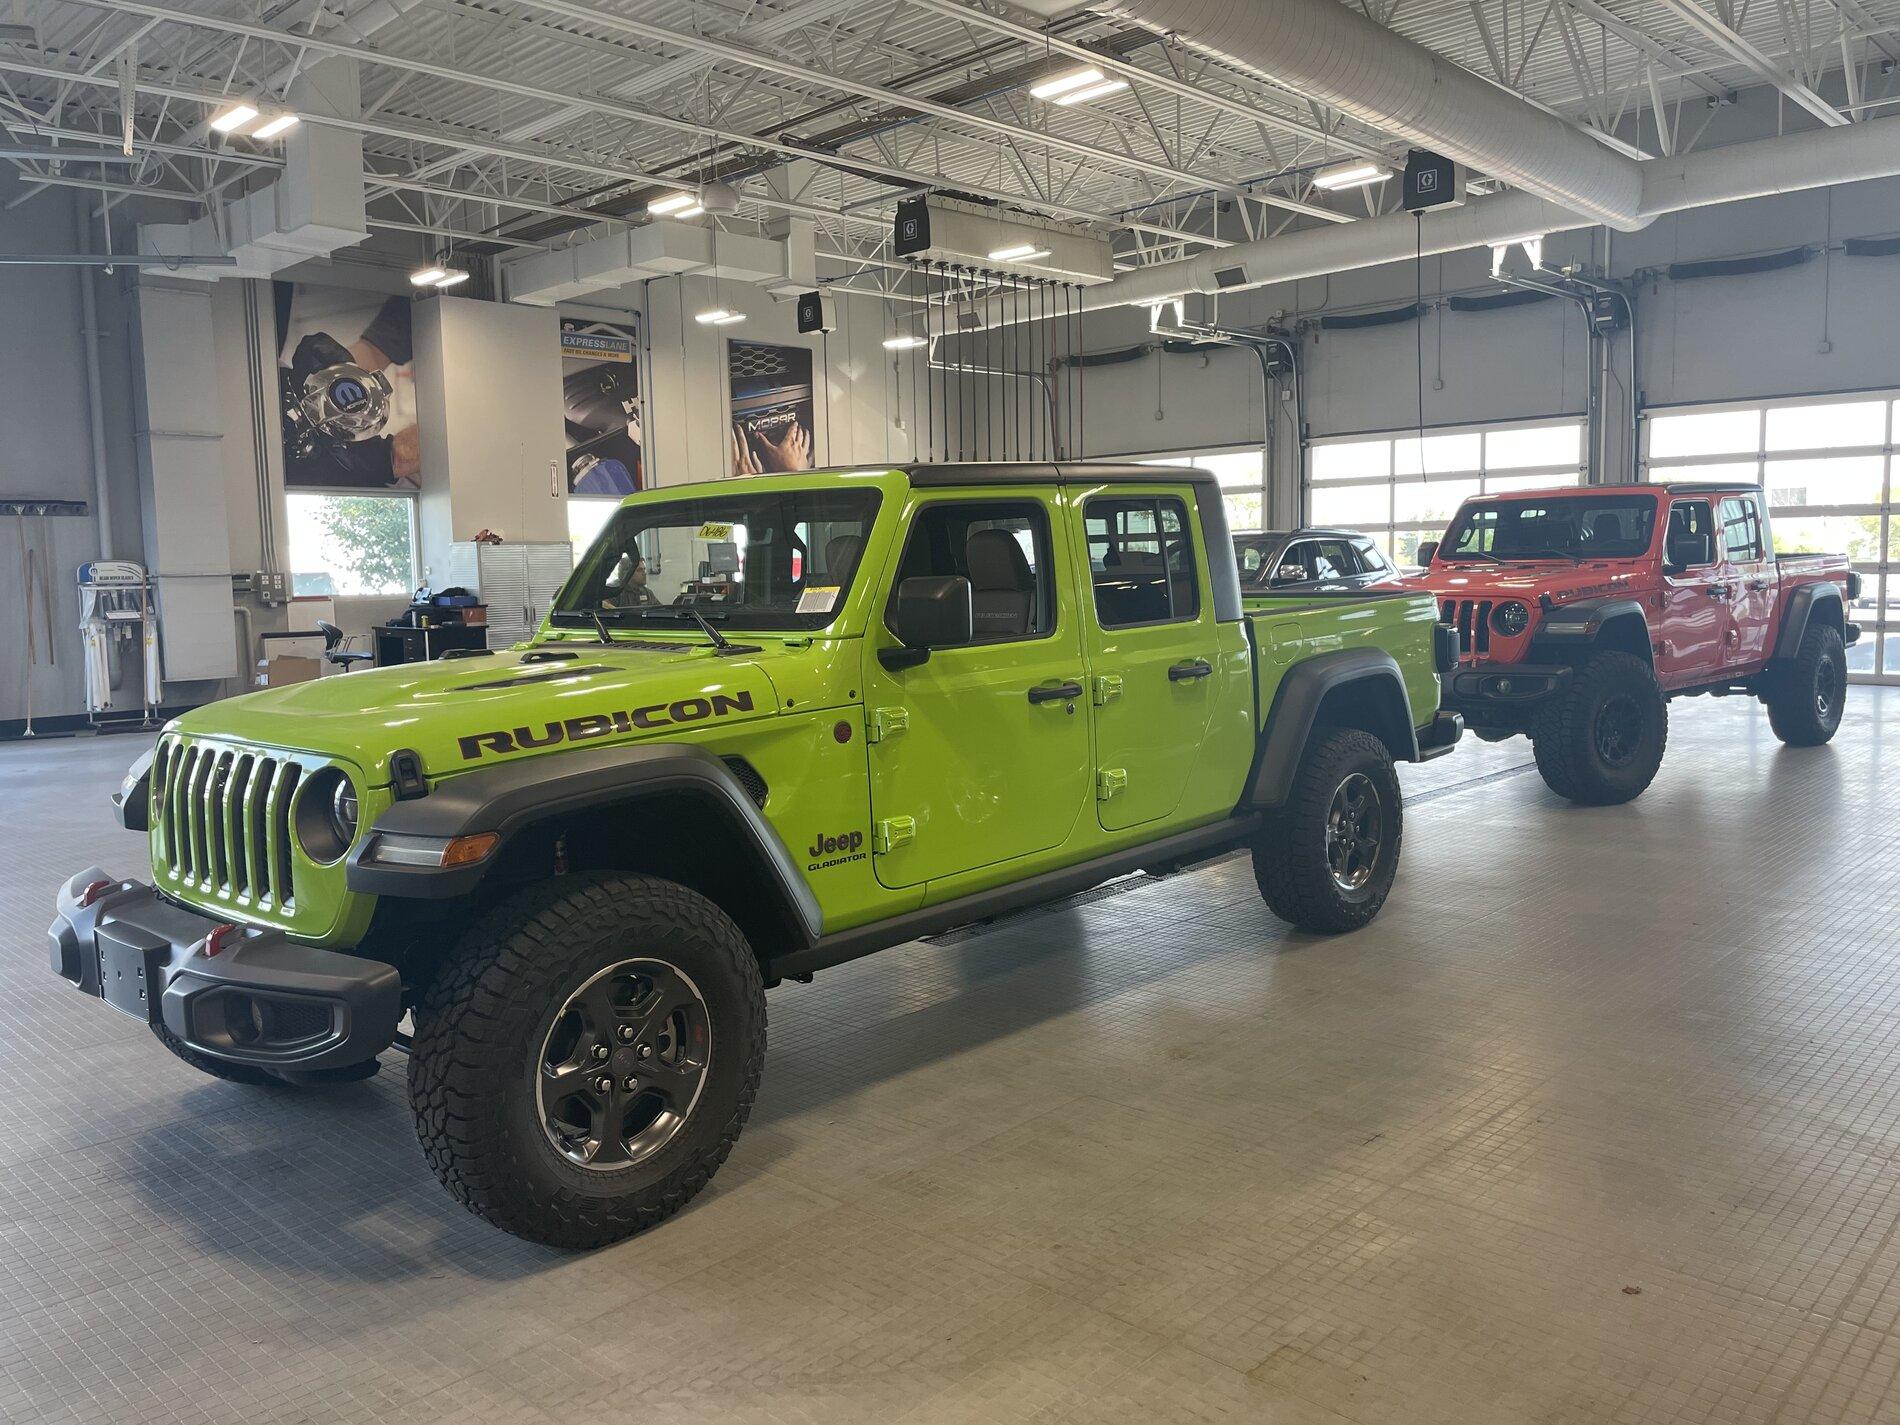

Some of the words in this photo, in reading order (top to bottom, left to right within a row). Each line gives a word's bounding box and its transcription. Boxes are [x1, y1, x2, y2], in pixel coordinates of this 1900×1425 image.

[748, 412, 796, 431] MOPAR
[457, 691, 755, 760] RUBICON
[809, 830, 863, 857] Jeep
[808, 852, 867, 872] GLADIATOR
